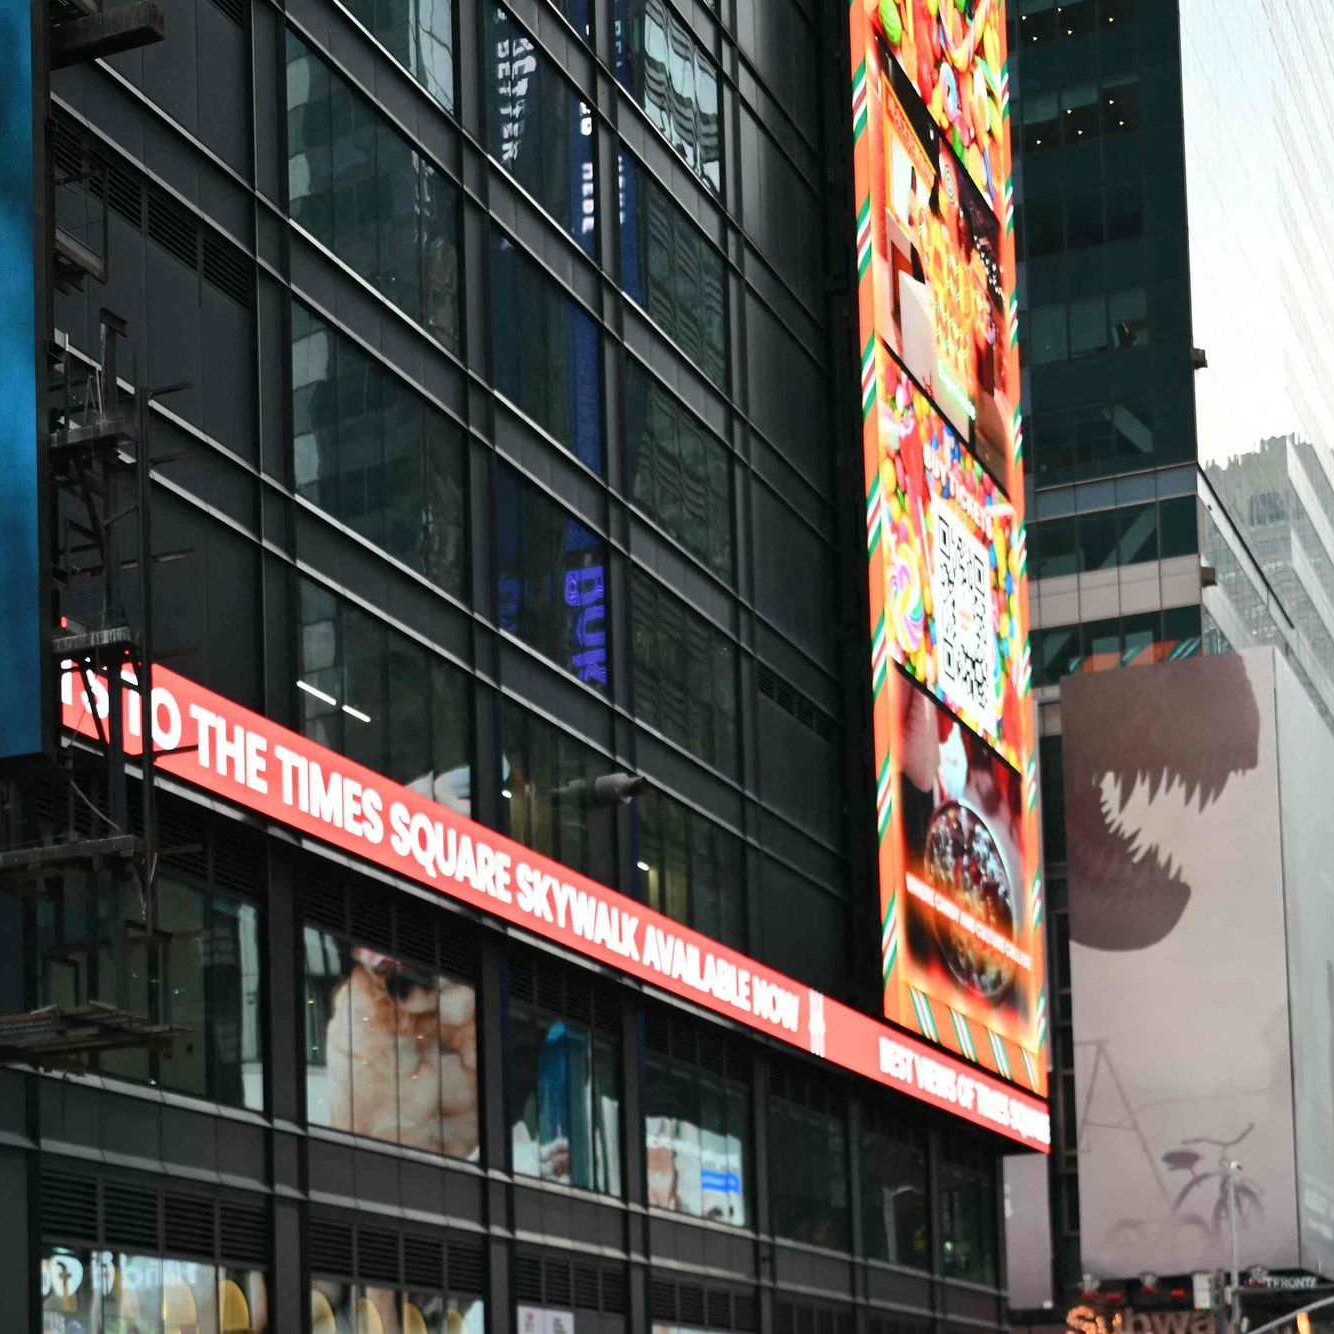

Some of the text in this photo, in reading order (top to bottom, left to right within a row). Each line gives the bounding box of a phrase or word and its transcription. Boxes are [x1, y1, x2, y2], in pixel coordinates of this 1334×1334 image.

[189, 703, 267, 794] THE
[274, 744, 384, 844] TIMES
[389, 802, 513, 904] SQUARE
[515, 862, 641, 961] SKYWALK
[643, 924, 752, 1012] AVAILABLE
[752, 975, 800, 1033] NOW
[957, 1075, 975, 1109] OF
